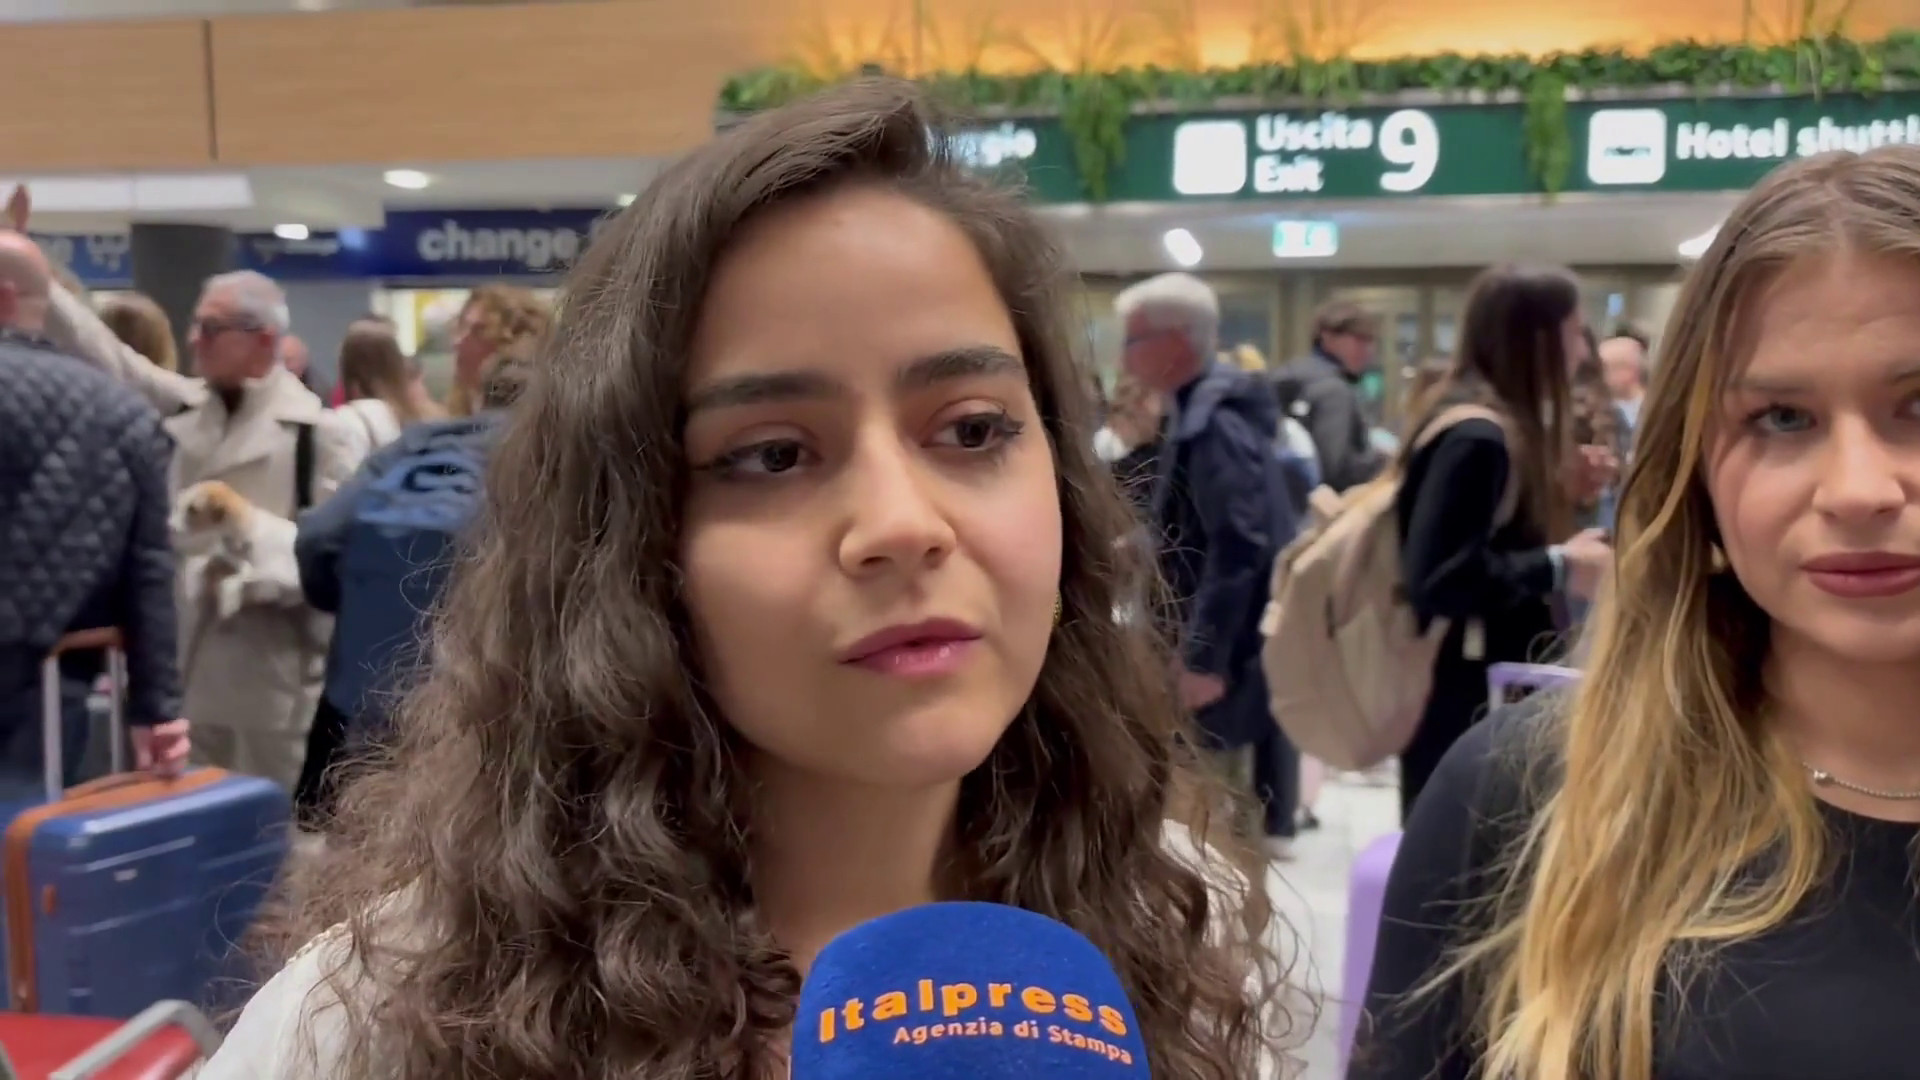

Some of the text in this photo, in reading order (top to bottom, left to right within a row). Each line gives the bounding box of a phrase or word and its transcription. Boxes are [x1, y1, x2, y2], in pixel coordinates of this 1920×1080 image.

[1256, 112, 1374, 151] Uscita
[1379, 109, 1440, 191] 9
[1675, 114, 1920, 160] Hotel shuttl
[1254, 155, 1325, 193] Exit
[417, 218, 579, 268] change
[819, 978, 1128, 1043] Italpress
[894, 1016, 1133, 1065] Agenzia di Stampa
